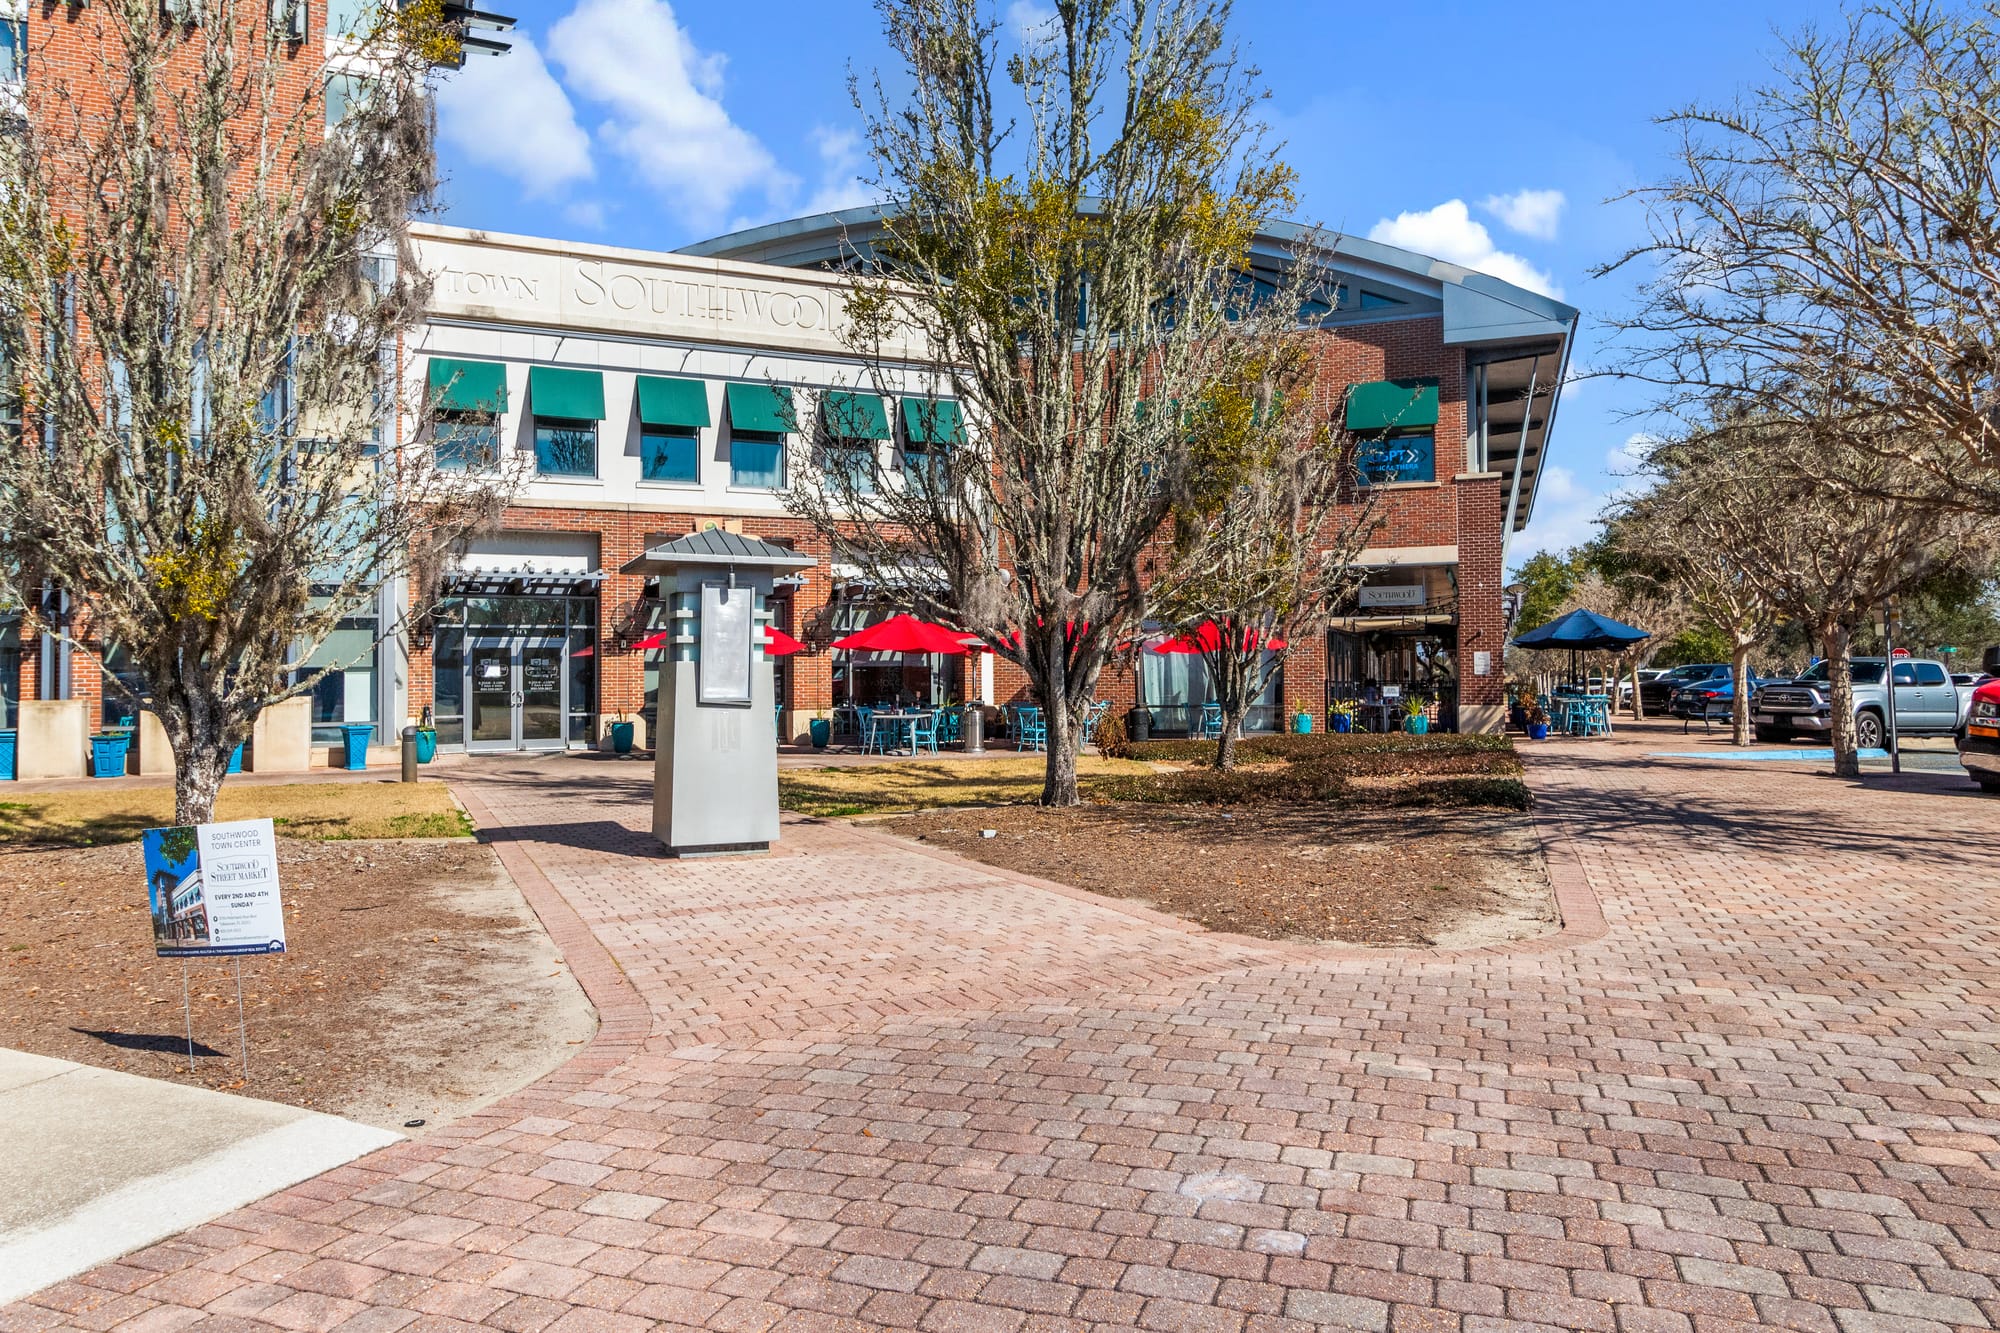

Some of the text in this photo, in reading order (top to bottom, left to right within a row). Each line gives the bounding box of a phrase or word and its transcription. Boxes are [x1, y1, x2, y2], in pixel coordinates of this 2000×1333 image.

[446, 270, 539, 302] TOWN
[211, 830, 259, 841] SOUTHWOOD
[211, 839, 261, 850] TOWN CENTER
[217, 859, 260, 871] SOUTHWOOD
[210, 867, 268, 882] STREET MARKET
